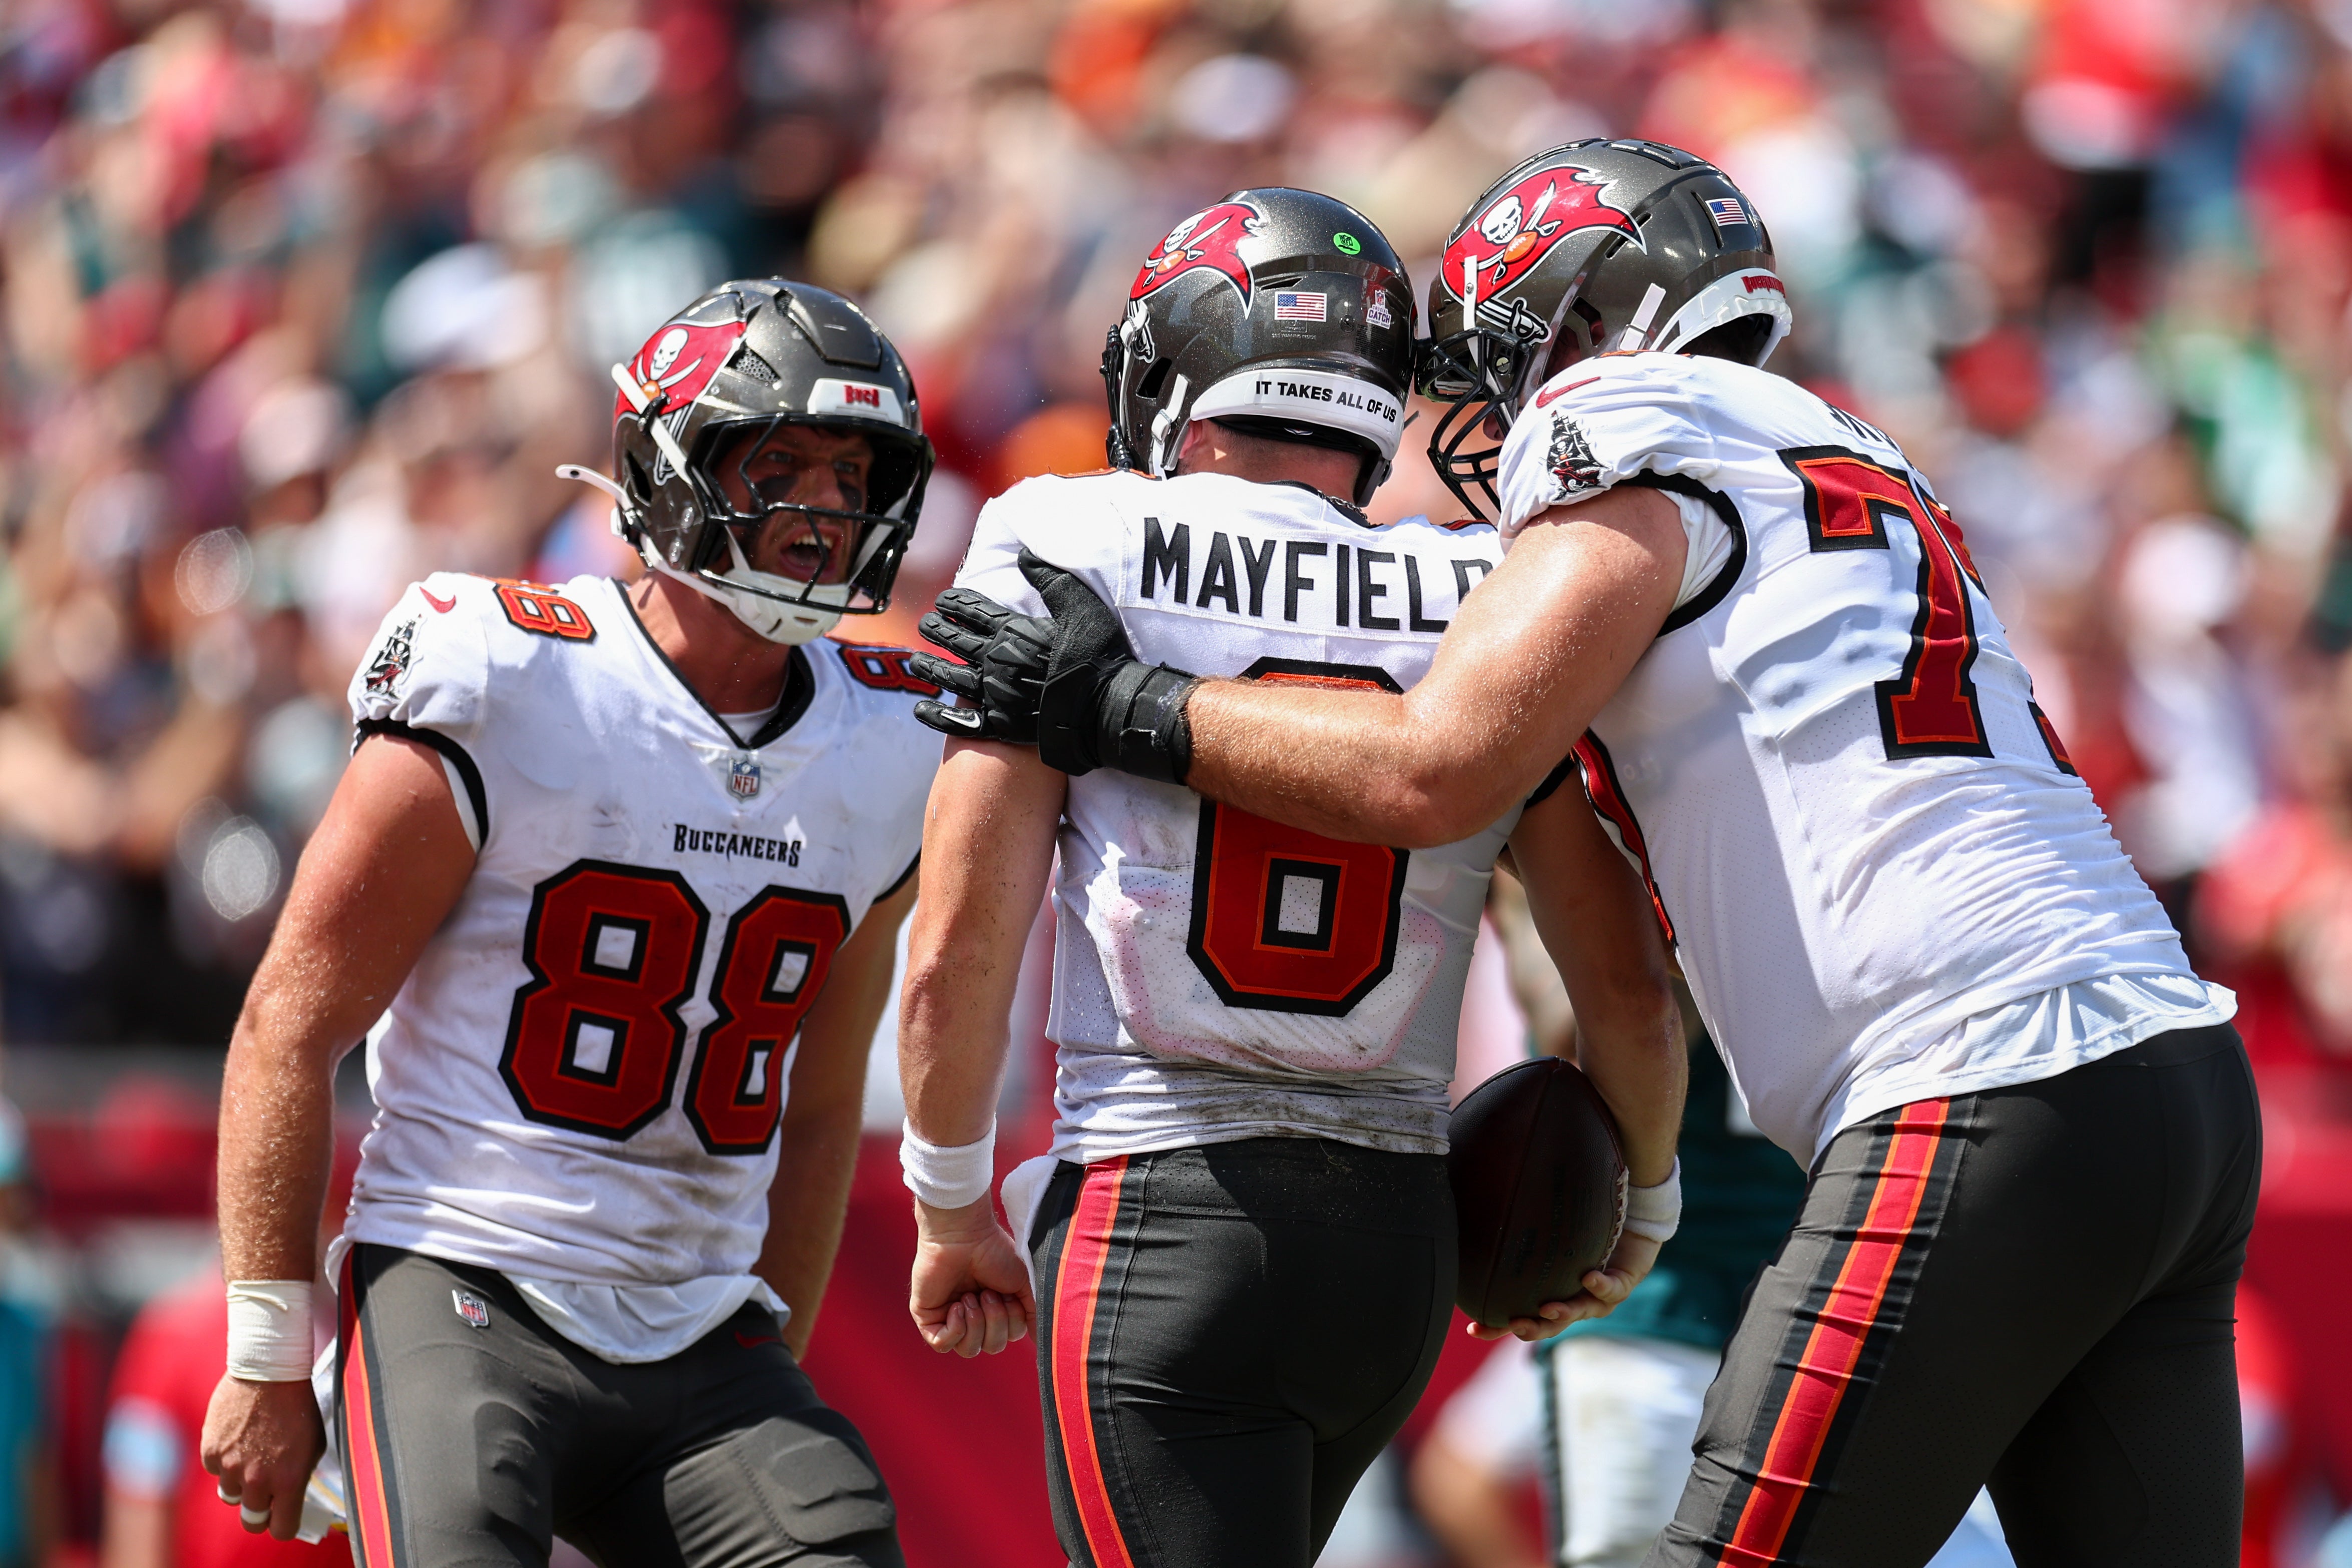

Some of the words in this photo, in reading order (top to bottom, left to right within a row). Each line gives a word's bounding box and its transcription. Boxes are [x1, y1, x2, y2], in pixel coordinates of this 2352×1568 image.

[1369, 309, 1390, 323] CATCH
[1372, 306, 1388, 314] CRUCIAL
[1256, 381, 1272, 395] IT
[1277, 382, 1333, 402] TAKES
[1336, 391, 1363, 410] ALL
[1367, 399, 1383, 414] OF
[1383, 405, 1397, 423] US
[733, 775, 757, 794] NFL
[673, 823, 802, 869] BUCCANEERS
[1186, 656, 1410, 1017] 6
[498, 857, 851, 1156] 88
[462, 1304, 485, 1322] NFL
